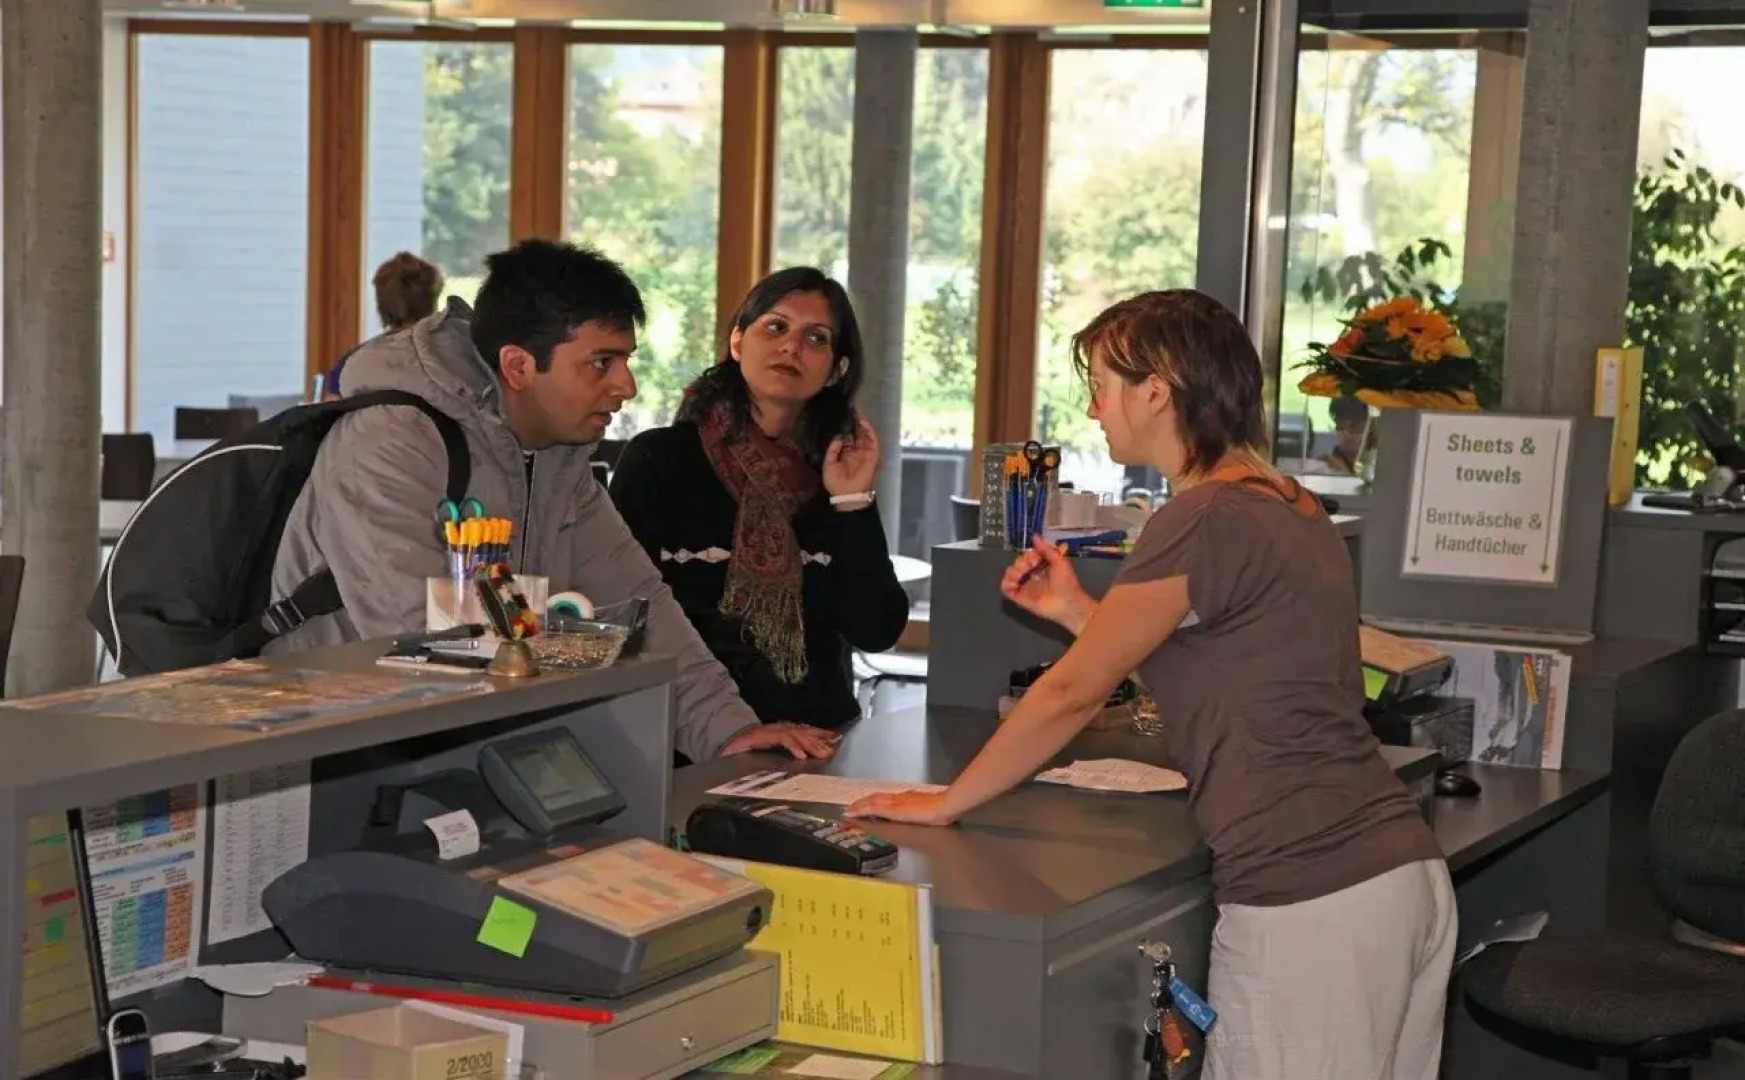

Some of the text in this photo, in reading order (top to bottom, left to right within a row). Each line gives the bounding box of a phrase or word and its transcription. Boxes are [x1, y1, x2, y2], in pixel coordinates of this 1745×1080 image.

[1447, 433, 1536, 455] Sheets &
[1456, 465, 1522, 485] towels
[1426, 507, 1543, 530] Bettwäsche &
[1434, 533, 1528, 556] Handtücher
